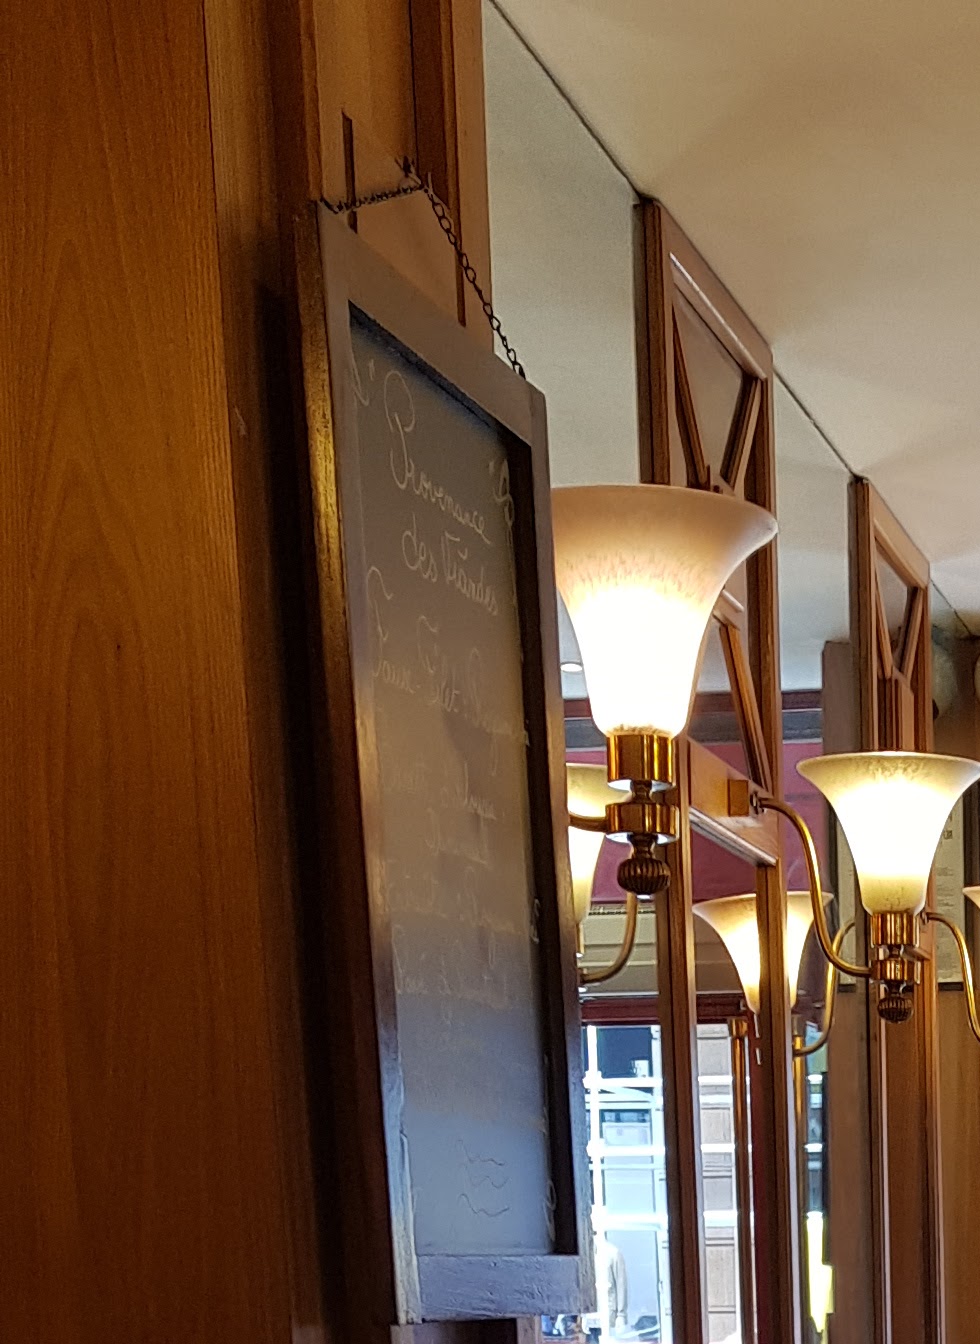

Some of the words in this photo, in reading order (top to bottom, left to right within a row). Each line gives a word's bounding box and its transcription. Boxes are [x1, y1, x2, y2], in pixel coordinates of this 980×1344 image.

[384, 370, 491, 544] Provenance
[402, 512, 438, 582] des
[440, 530, 498, 616] Viandes
